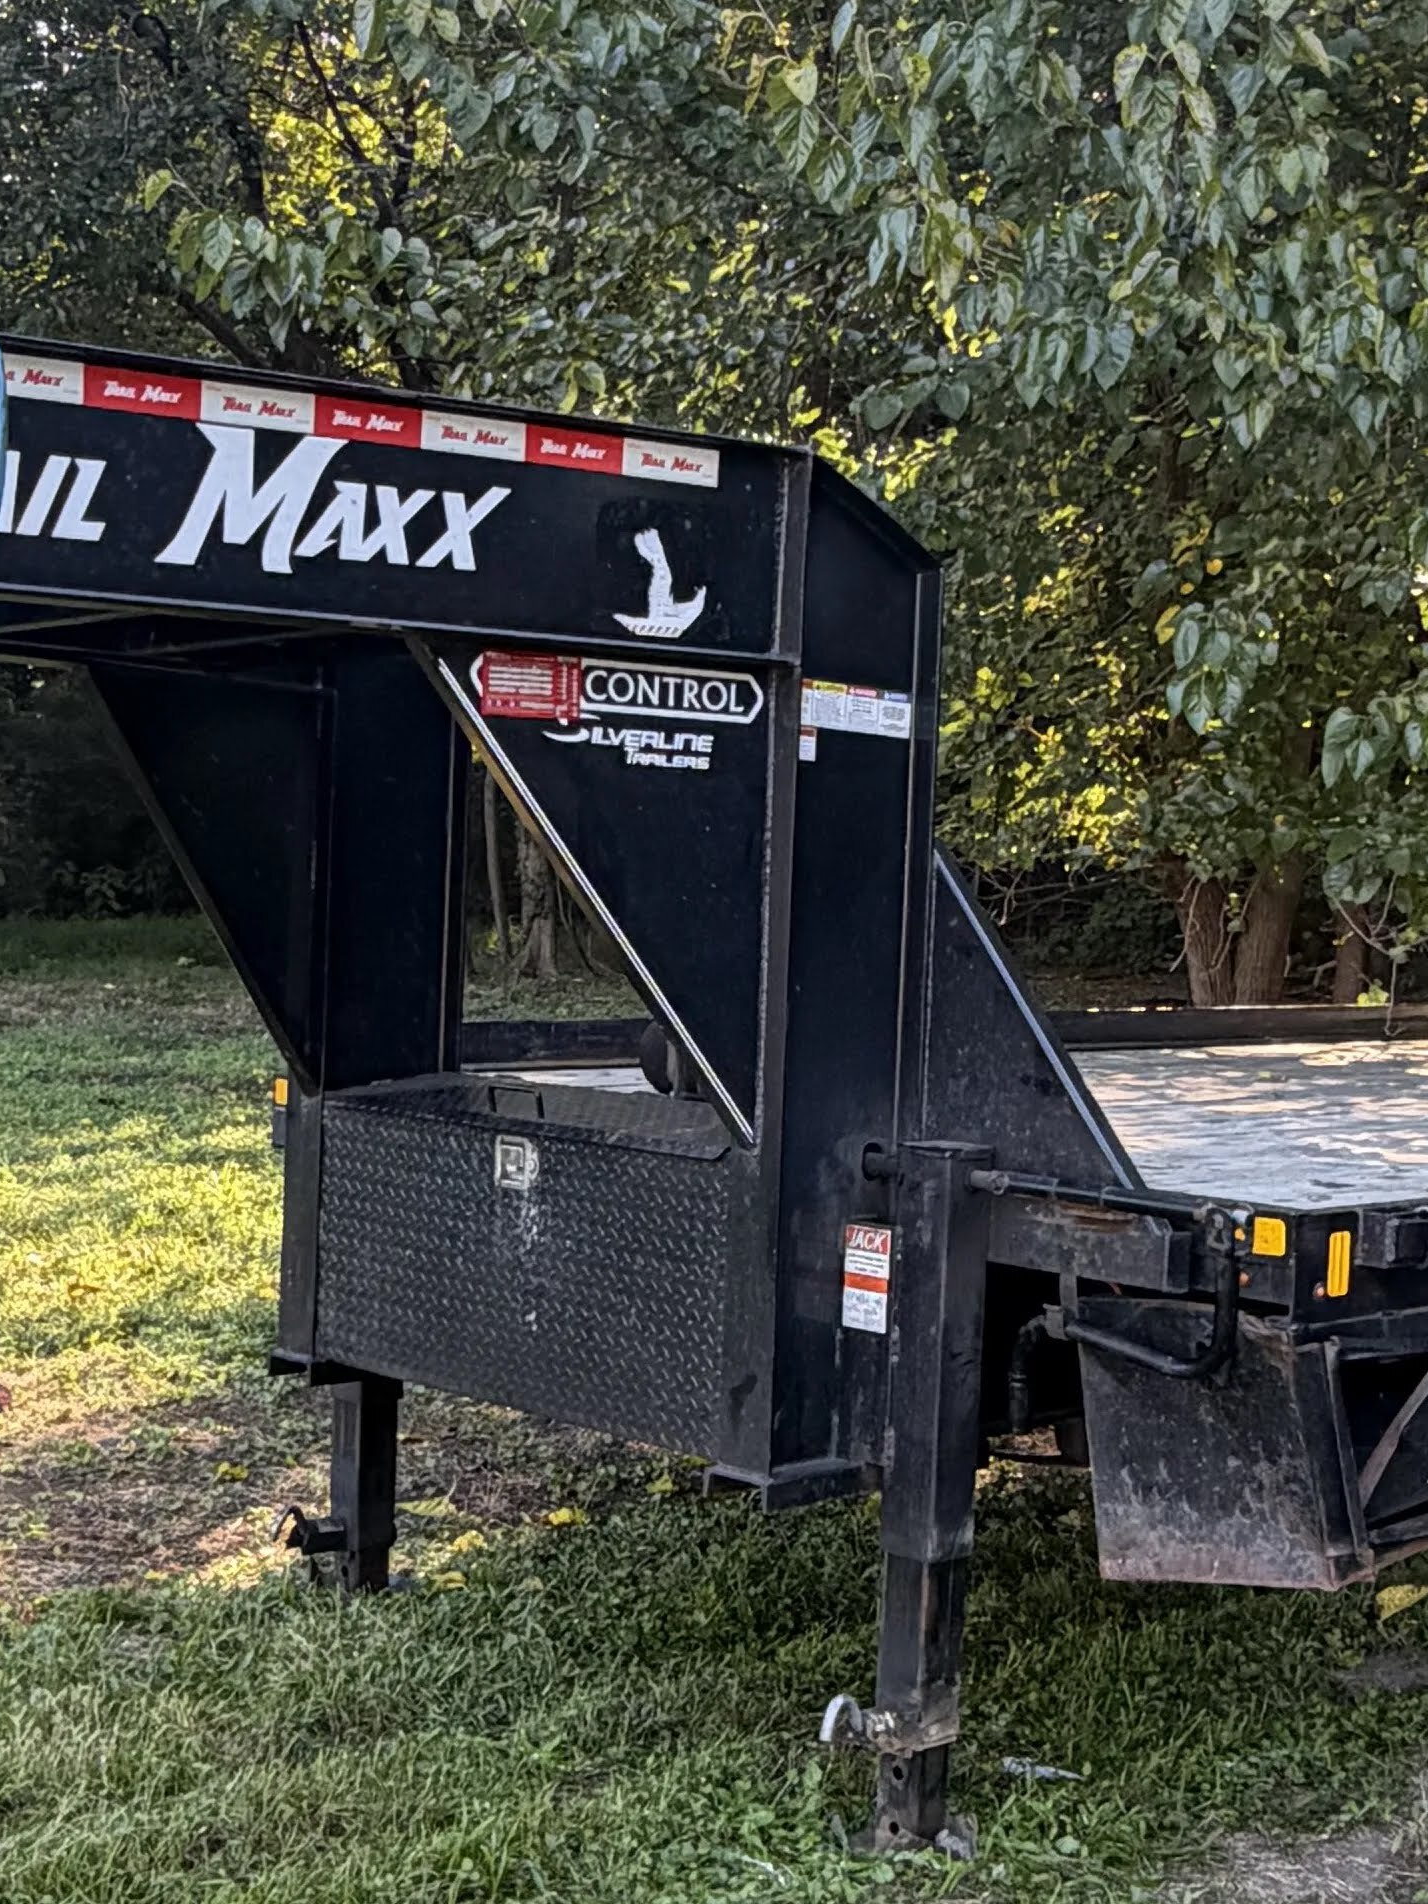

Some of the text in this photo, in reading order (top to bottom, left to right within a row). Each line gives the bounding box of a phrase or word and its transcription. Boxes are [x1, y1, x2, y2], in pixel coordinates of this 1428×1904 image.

[154, 421, 513, 574] MAXX
[585, 670, 746, 713] CONTROL
[624, 746, 710, 770] TRAILERS
[849, 1229, 887, 1252] JACK
